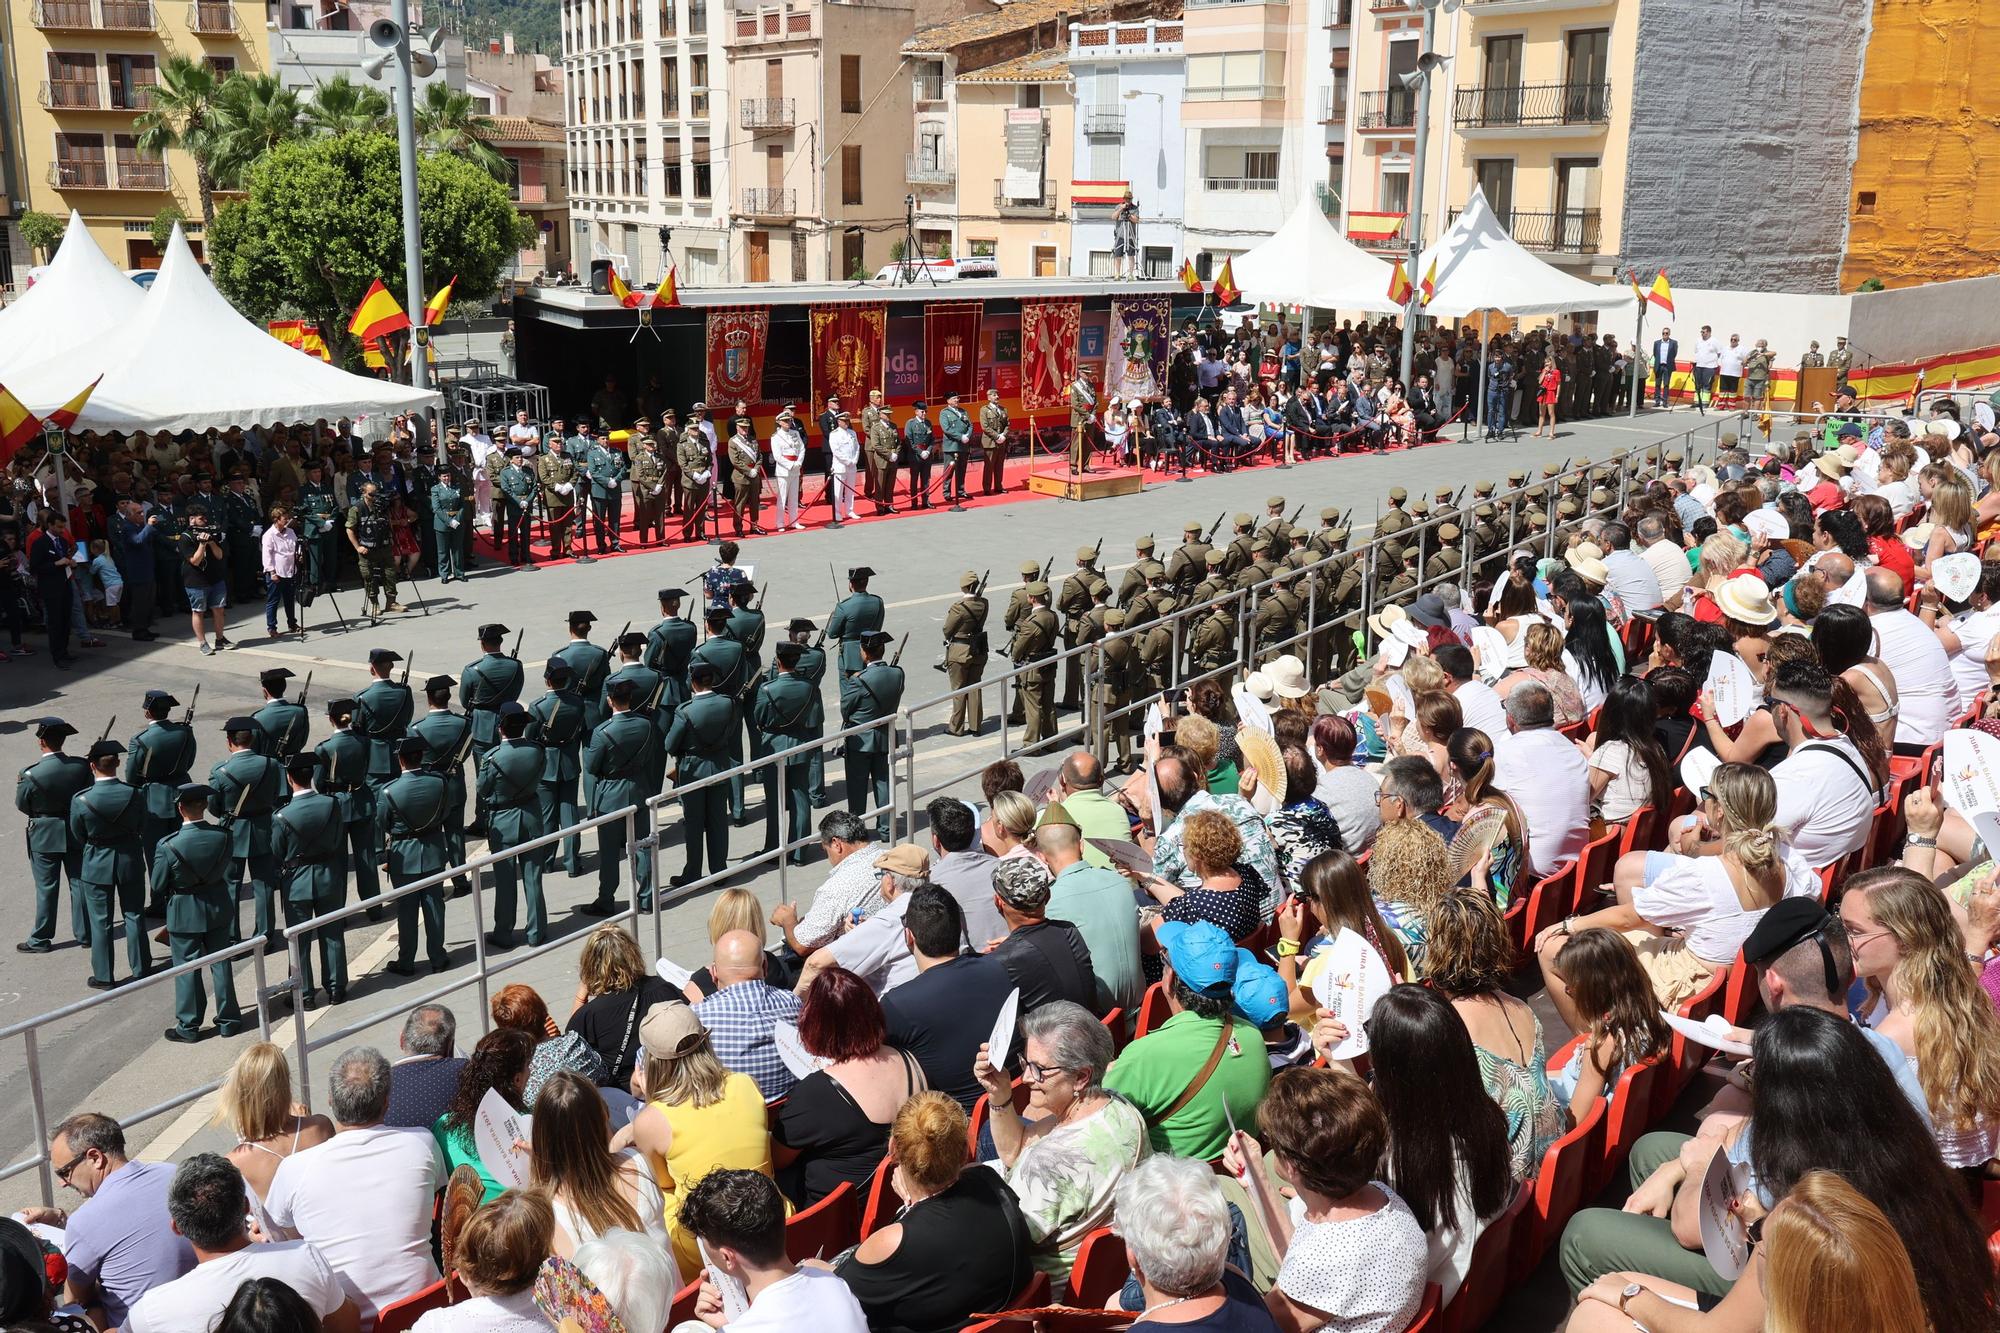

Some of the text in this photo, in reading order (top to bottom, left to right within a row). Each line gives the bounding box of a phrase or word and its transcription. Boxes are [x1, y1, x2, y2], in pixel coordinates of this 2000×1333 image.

[895, 373, 918, 384] 2030
[1968, 735, 1980, 754] JURA
[1359, 972, 1366, 984] DE
[481, 1110, 491, 1128] 2022
[489, 1128, 505, 1159] BANDERA
[512, 1169, 522, 1186] JURA
